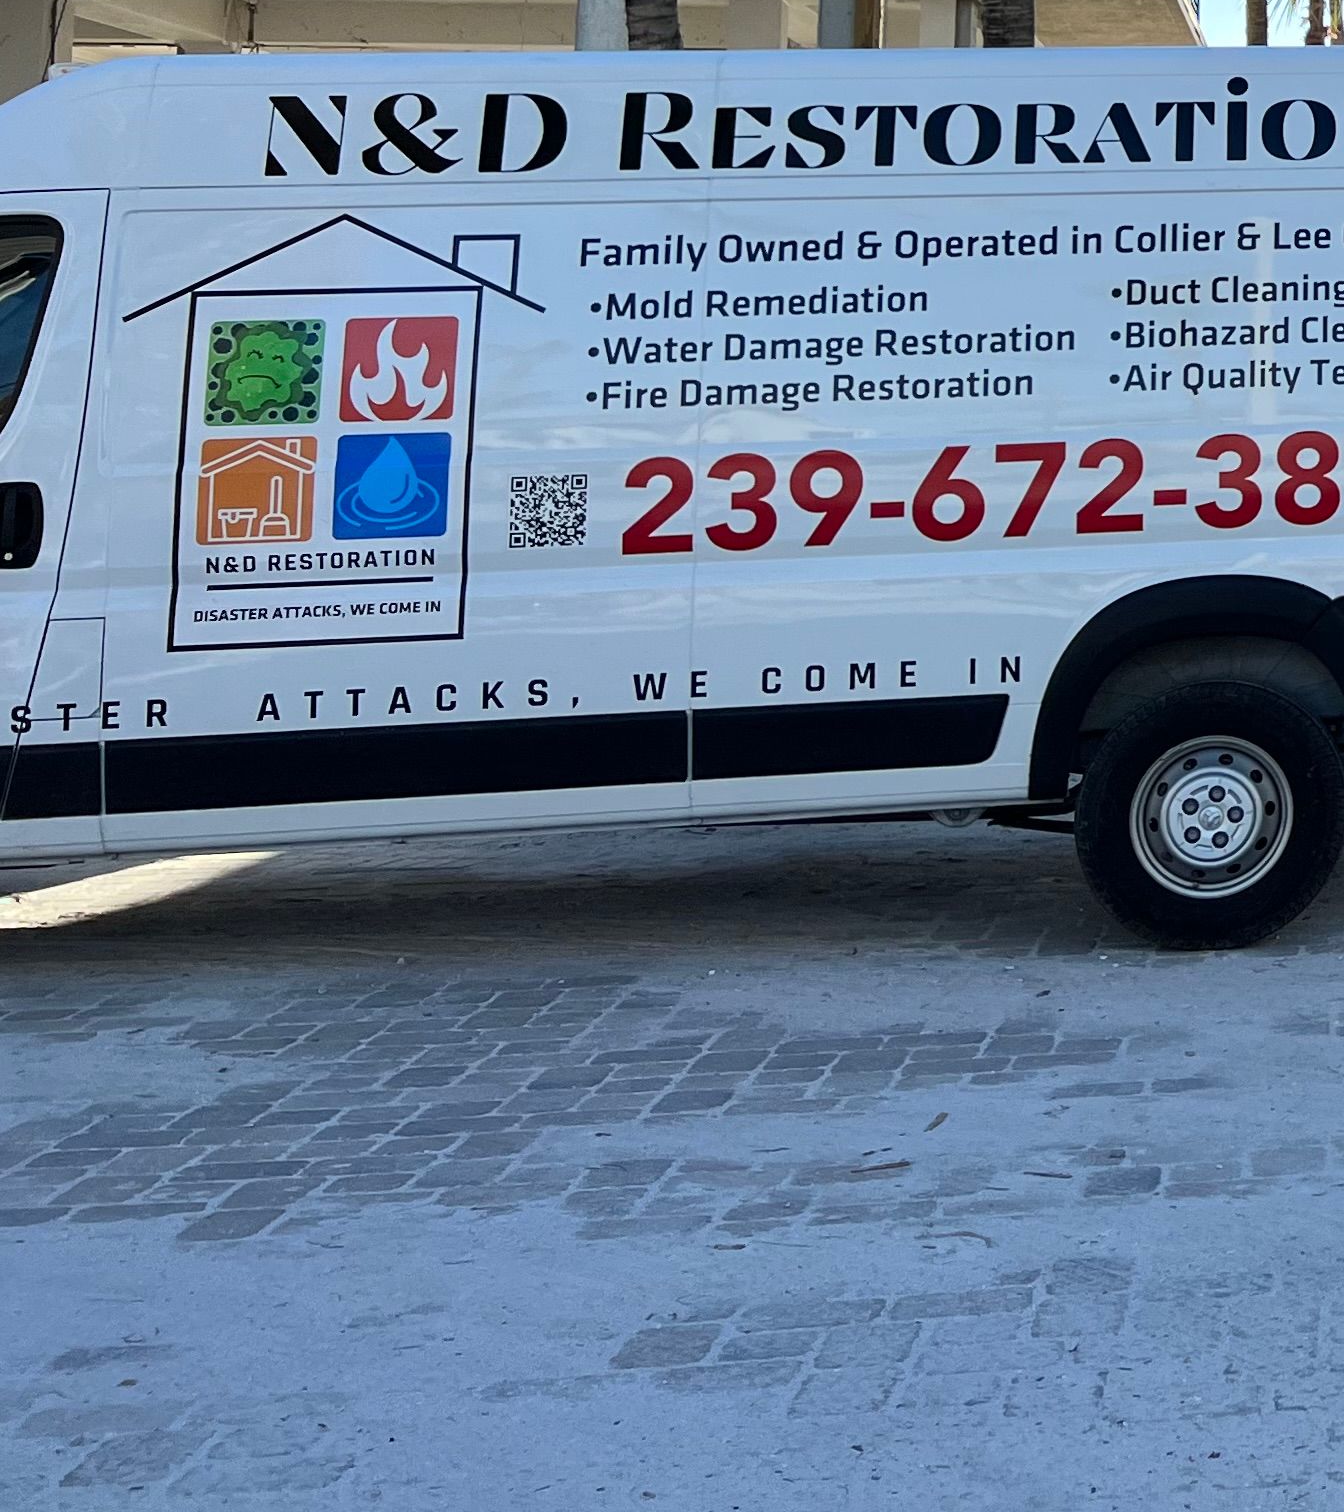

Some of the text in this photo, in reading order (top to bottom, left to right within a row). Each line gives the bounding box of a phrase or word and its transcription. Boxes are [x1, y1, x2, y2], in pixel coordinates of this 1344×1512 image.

[265, 93, 567, 176] N&D
[581, 235, 707, 272] Family
[719, 231, 843, 263] Owned
[858, 231, 882, 259] &
[896, 226, 1057, 266] Operated
[1072, 226, 1101, 254] in
[1116, 223, 1225, 253] Collier
[1238, 223, 1260, 250] &
[1274, 223, 1330, 249] Lee
[606, 285, 927, 320] Mold Remediation
[1127, 280, 1200, 305] Duct
[604, 324, 1074, 365] Water Damage Restoration
[1126, 317, 1289, 348] Biohazard
[603, 369, 1032, 411] Fire Damage Restoration
[1124, 363, 1172, 391] Air
[1184, 360, 1301, 395] Quality
[206, 549, 434, 573] N&D RESTORATION
[194, 600, 442, 622] DISASTER ATTACKS, WE COME IN
[11, 656, 1020, 734] STER ATTACKS, WE COME IN
